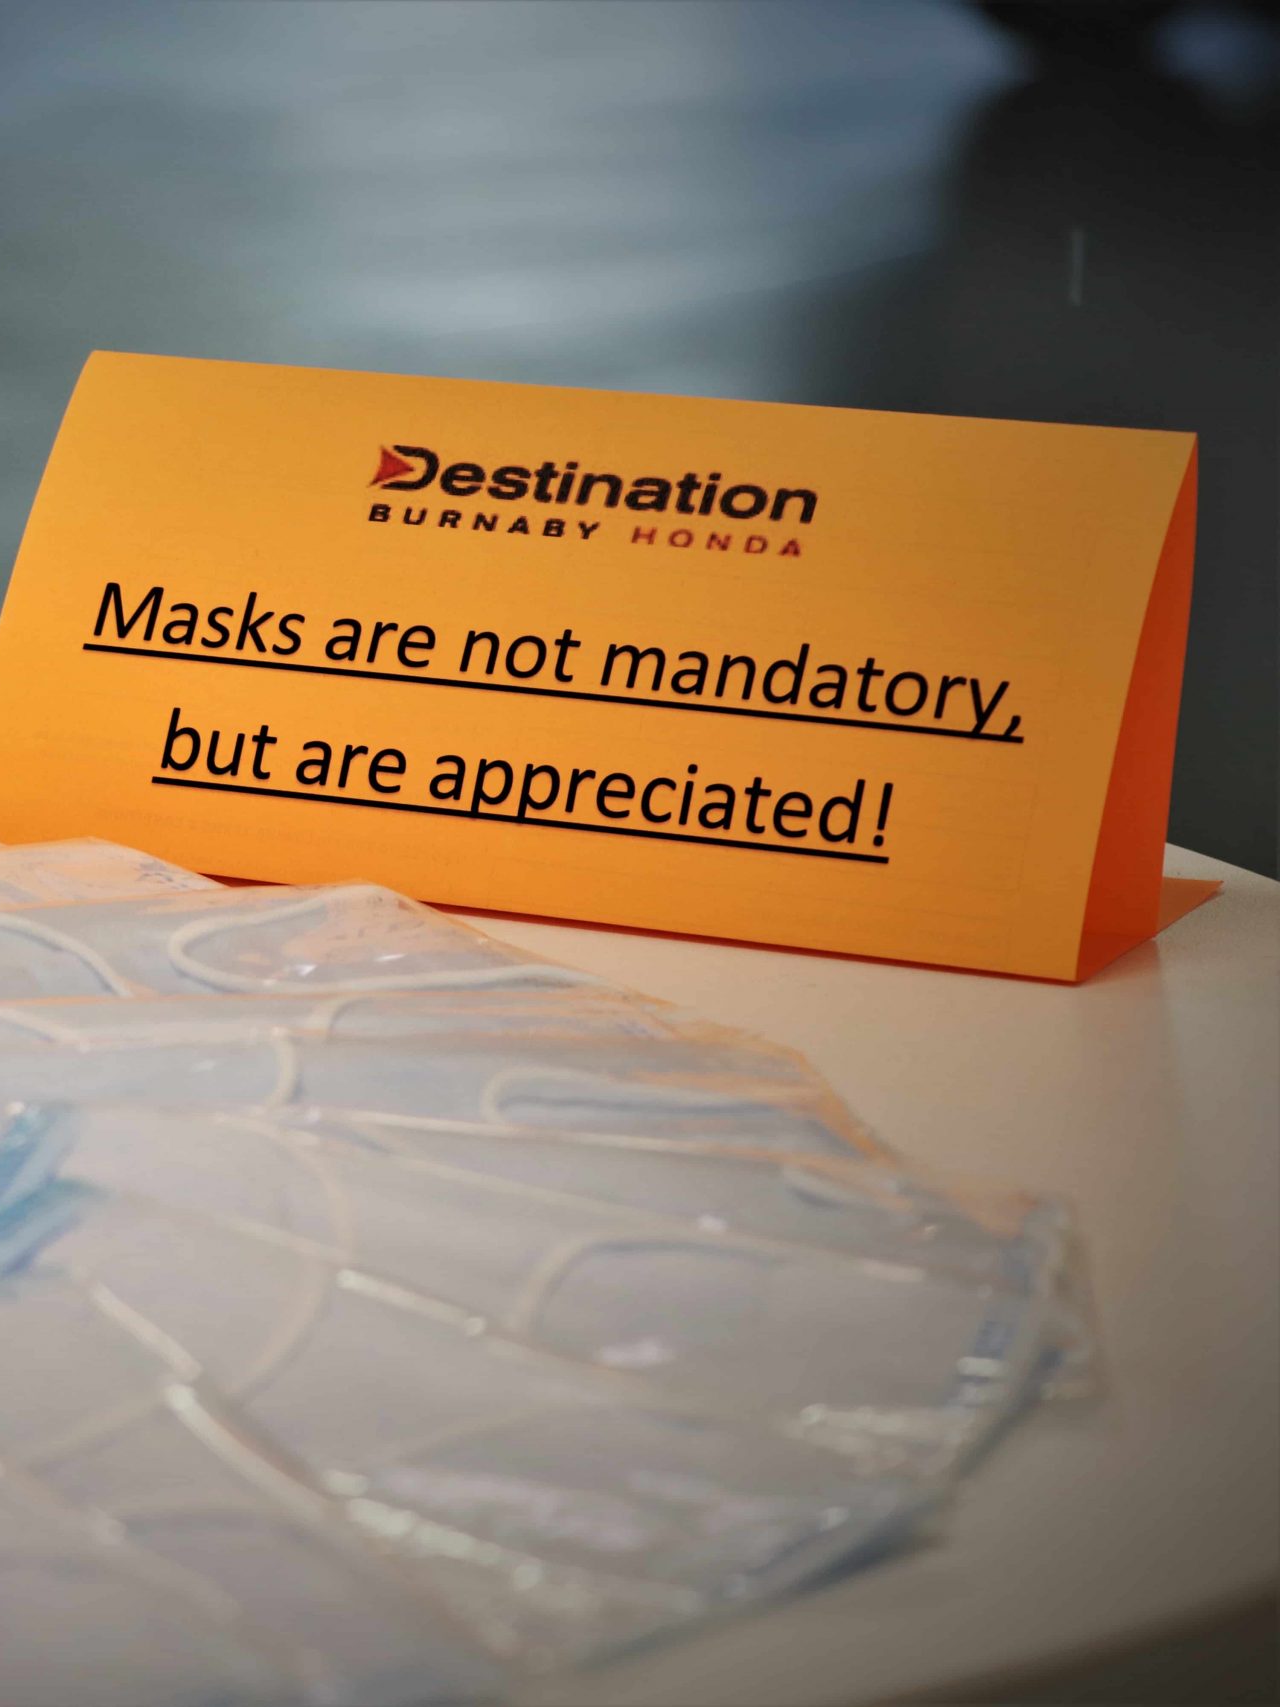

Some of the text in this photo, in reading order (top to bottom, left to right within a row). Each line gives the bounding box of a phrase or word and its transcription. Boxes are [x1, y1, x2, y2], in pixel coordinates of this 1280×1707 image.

[367, 444, 819, 524] Destination
[367, 502, 803, 558] BURNABY HONDA
[92, 581, 1023, 742] Masks are not mandatory,
[159, 706, 895, 849] but are appreciated!
